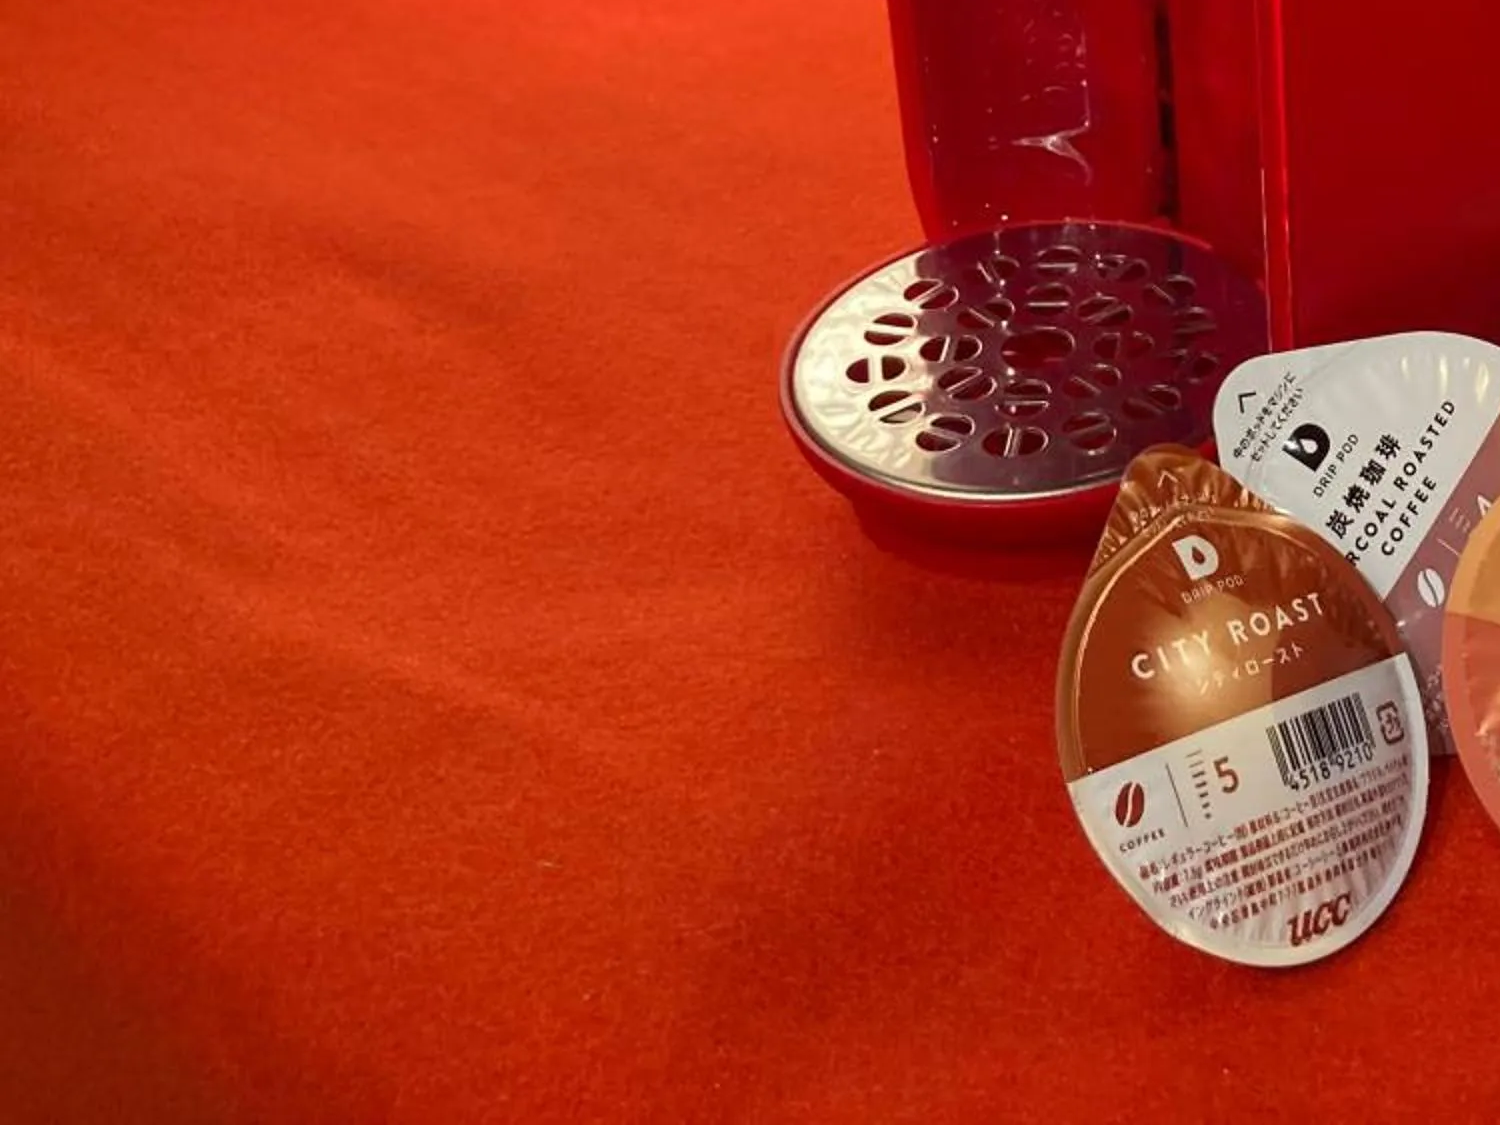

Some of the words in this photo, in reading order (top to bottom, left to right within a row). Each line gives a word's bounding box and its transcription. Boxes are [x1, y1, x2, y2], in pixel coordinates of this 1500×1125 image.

[1313, 463, 1339, 498] DRIP
[1339, 433, 1361, 464] POD
[1324, 433, 1402, 540] 炭焼珈琲
[1346, 496, 1397, 568] RCOAL
[1393, 399, 1456, 491] ROASTED
[1381, 475, 1438, 556] COFFEE
[1180, 582, 1213, 605] DRIP
[1217, 574, 1244, 592] POD
[1131, 630, 1211, 681] CITY
[1226, 592, 1323, 646] ROAST
[1213, 755, 1240, 794] 5
